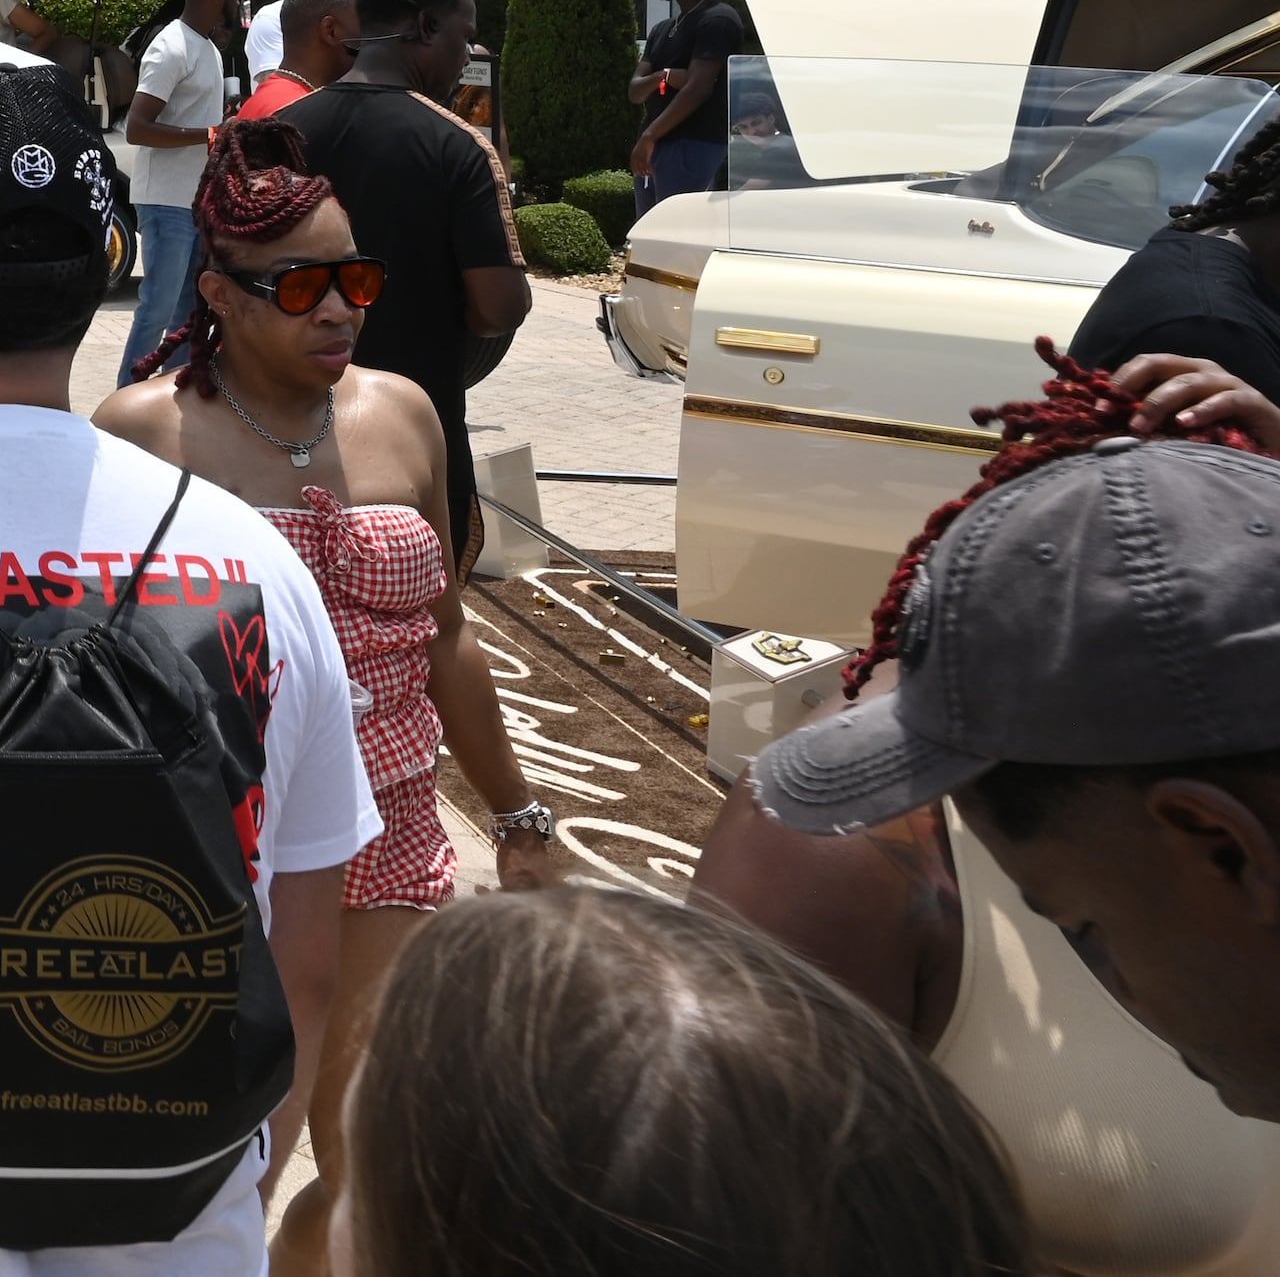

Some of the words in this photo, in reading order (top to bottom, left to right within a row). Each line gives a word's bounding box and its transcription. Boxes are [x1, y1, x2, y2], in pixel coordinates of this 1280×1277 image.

[55, 882, 86, 907] 24
[51, 1020, 95, 1051] BAIL
[102, 1019, 181, 1054] BONDS
[0, 1090, 210, 1117] freeatlastbb.com
